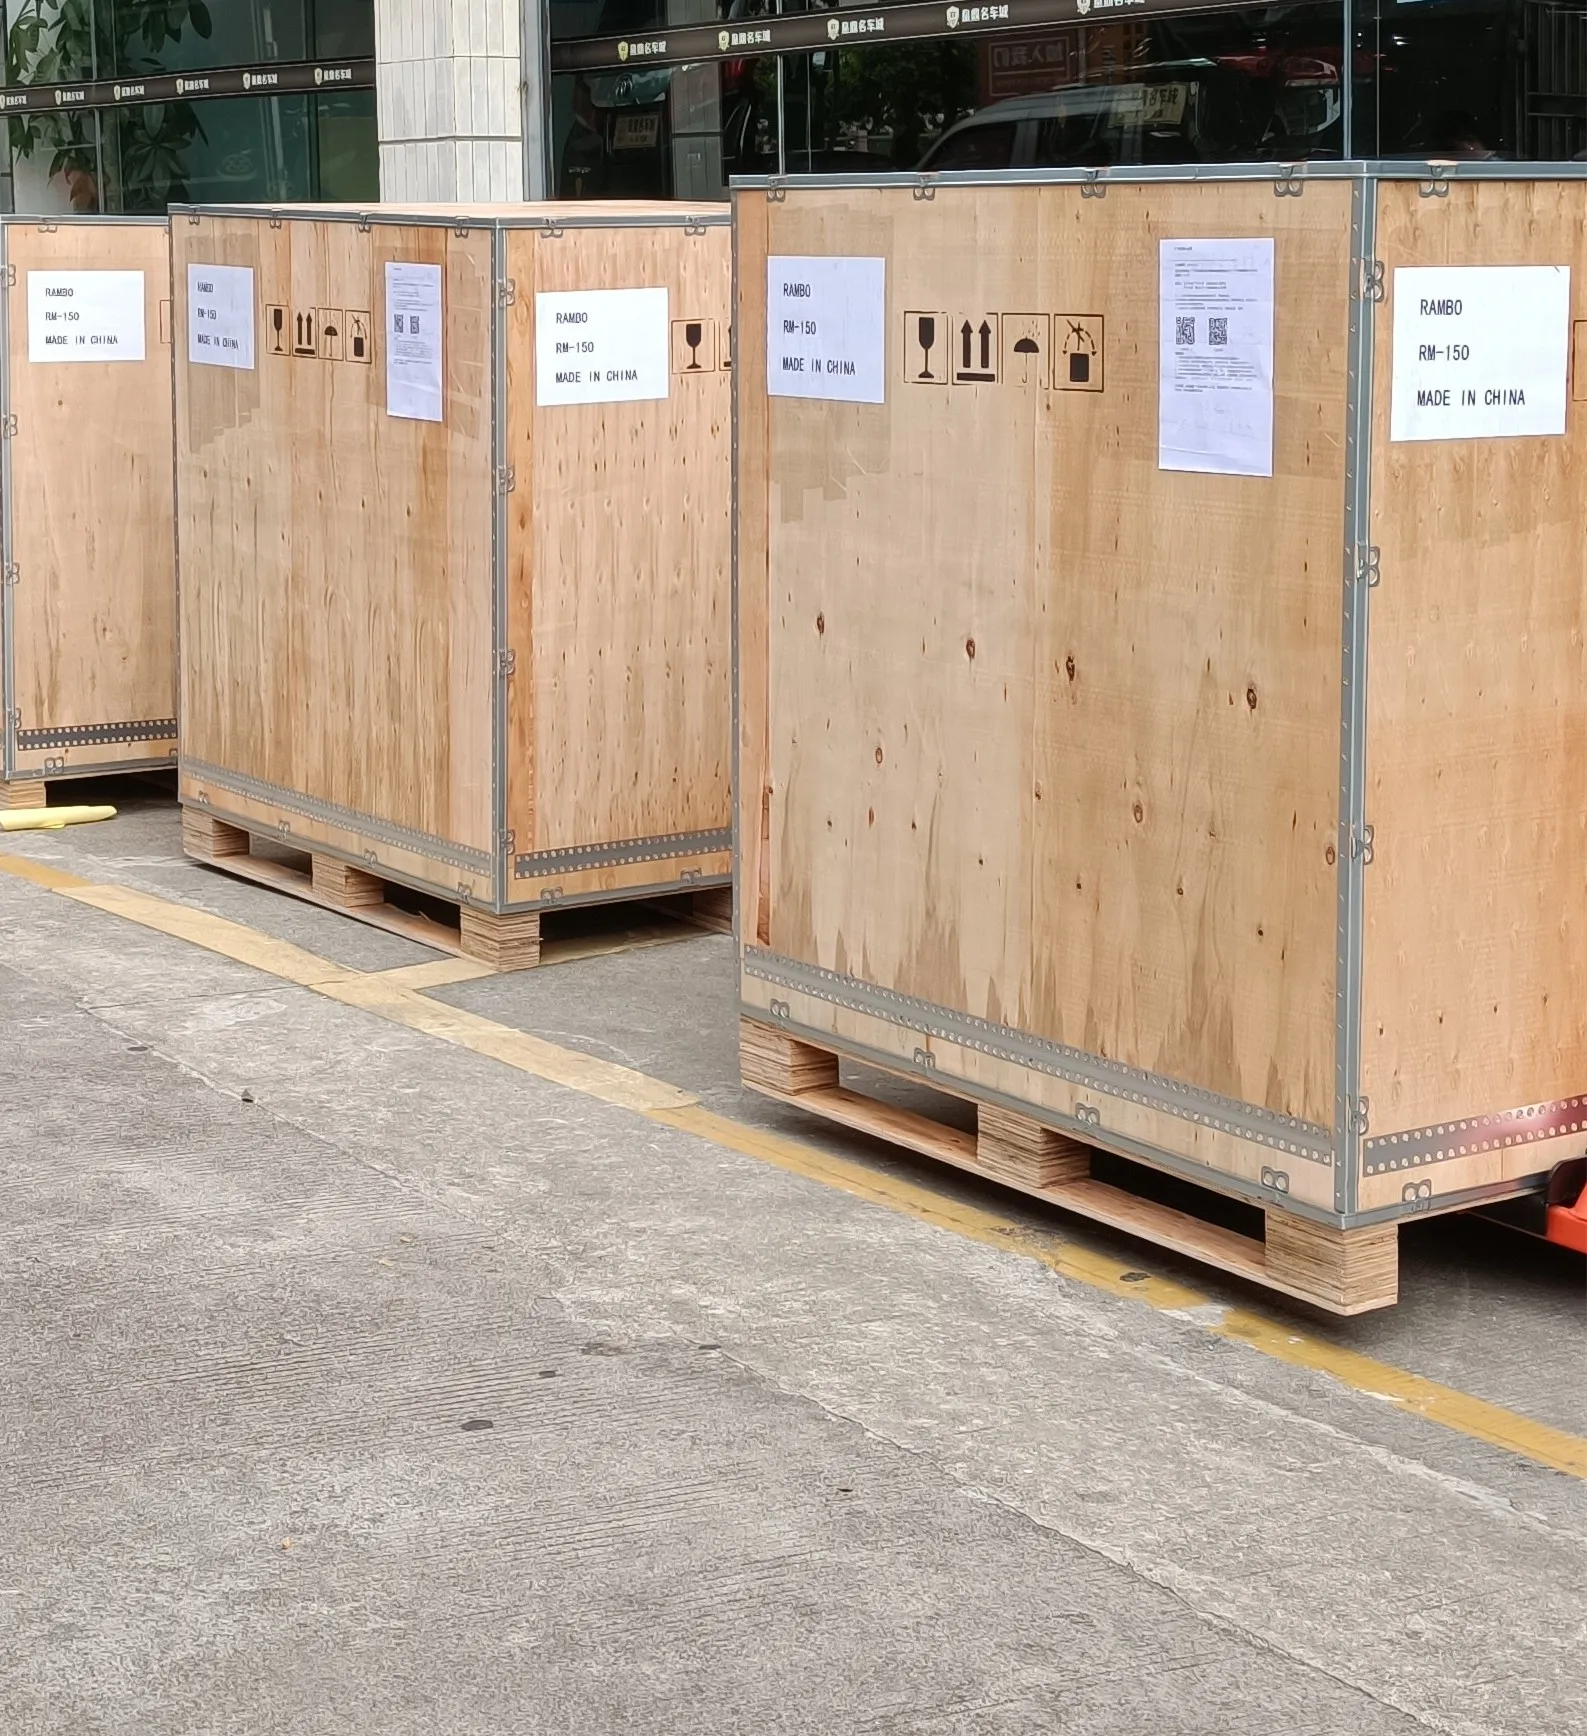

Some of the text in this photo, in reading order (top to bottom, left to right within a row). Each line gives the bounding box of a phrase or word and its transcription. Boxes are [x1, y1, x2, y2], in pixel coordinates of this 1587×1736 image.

[45, 288, 74, 297] RAMBO
[783, 283, 811, 298] RAMBO
[1420, 299, 1463, 316] RAMBO
[45, 312, 80, 321] RM-150
[556, 312, 588, 324] RAMBO
[783, 320, 817, 335] RM-150
[45, 335, 118, 345] MADE IN CHINA
[555, 341, 595, 354] RM-150
[1418, 344, 1470, 361] RM-150
[782, 357, 856, 375] MADE IN CHINA
[555, 370, 638, 383] MADE IN CHINA
[1417, 389, 1526, 406] MADE IN CHINA
